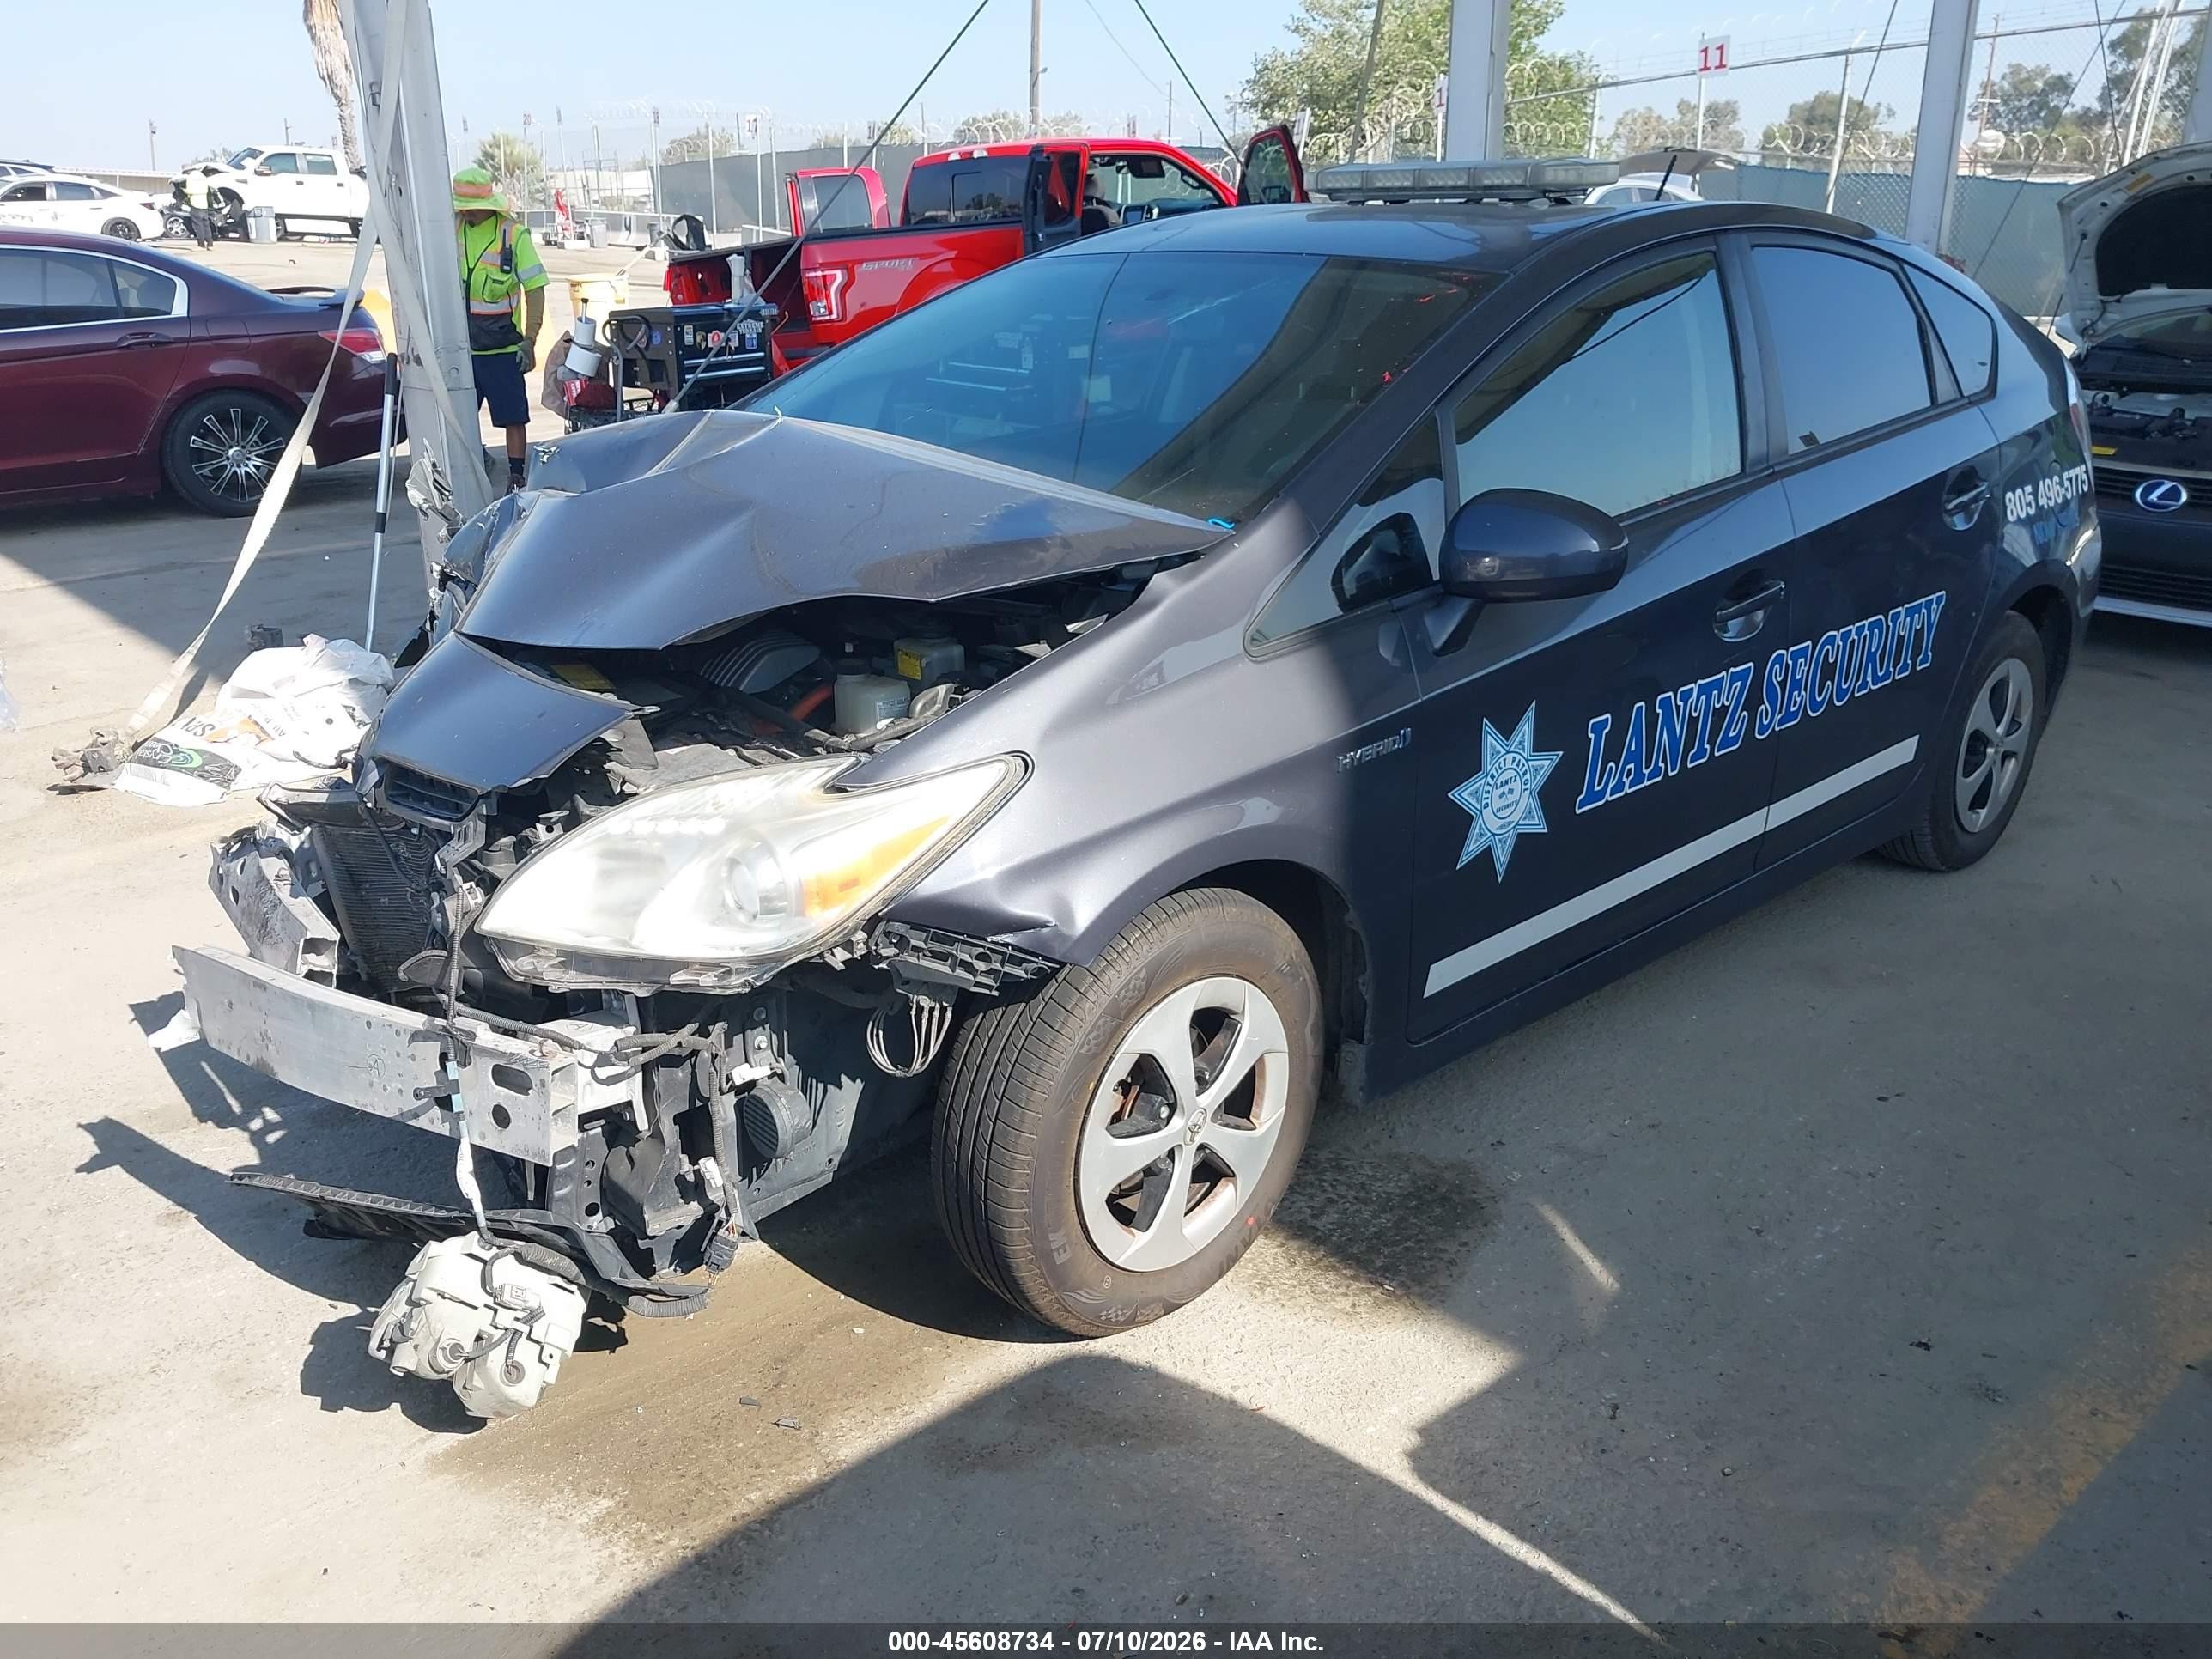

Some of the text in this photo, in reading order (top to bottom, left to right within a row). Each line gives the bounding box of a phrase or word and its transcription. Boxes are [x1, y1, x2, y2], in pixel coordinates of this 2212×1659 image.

[1698, 43, 1727, 72] 11
[2005, 465, 2089, 522] 805 496-5775
[1575, 591, 1947, 814] LANTZ SECURITY
[1482, 756, 1530, 810] DISTRICT PATROL
[1494, 775, 1518, 791] LANTZ
